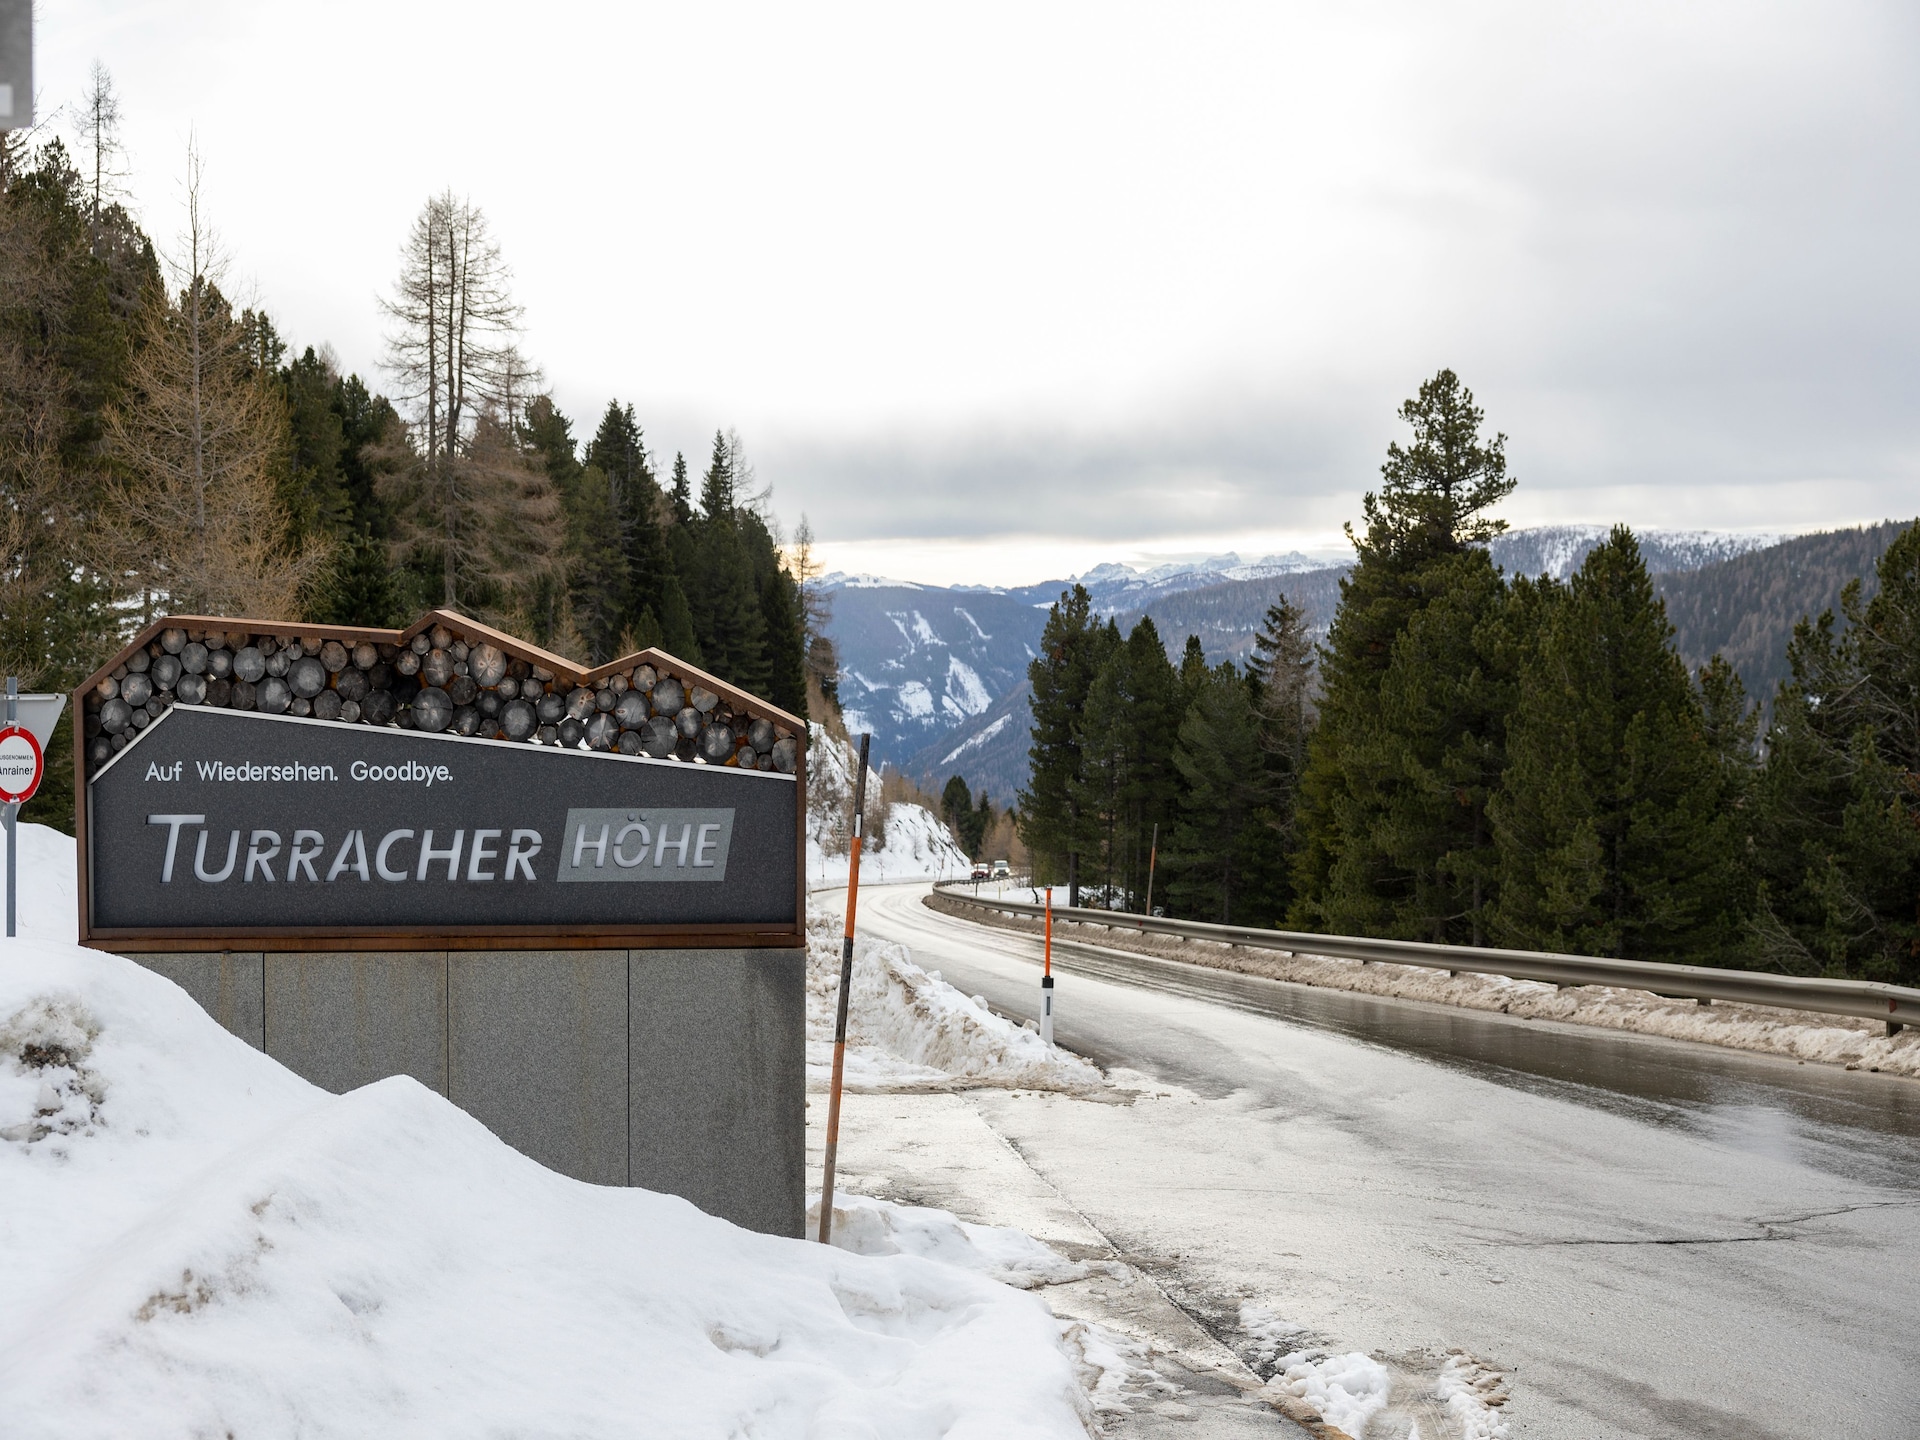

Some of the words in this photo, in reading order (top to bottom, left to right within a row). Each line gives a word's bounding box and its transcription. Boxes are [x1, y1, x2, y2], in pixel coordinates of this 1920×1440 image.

[145, 761, 182, 781] Auf
[196, 760, 338, 781] Wiedersehen.
[350, 760, 454, 787] Goodbye.
[146, 814, 543, 882] TURRACHER
[571, 813, 721, 868] HÖHE
